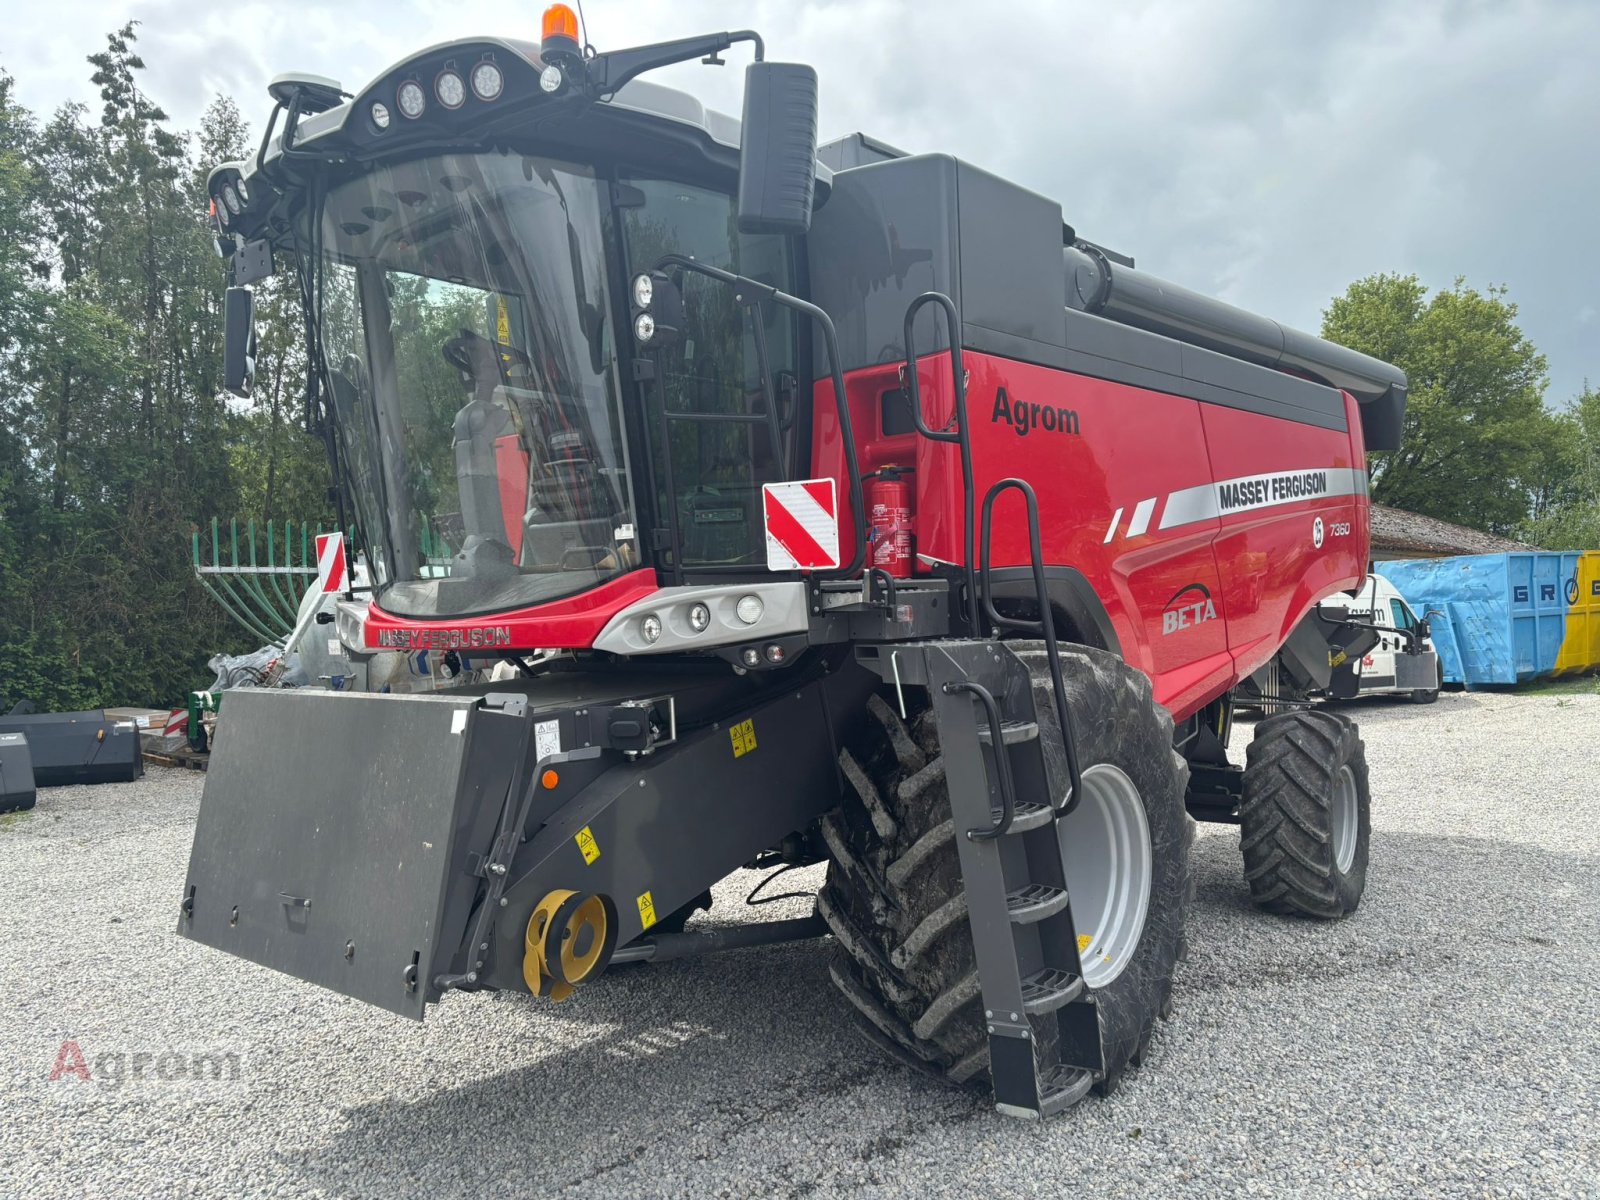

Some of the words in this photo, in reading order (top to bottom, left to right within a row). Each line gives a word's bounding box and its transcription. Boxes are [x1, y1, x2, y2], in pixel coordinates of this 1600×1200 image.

[991, 386, 1080, 436] Agrom
[1220, 479, 1269, 509] MASSEY
[1272, 472, 1326, 500] FERGUSON
[1329, 523, 1350, 537] 7360
[1162, 598, 1217, 636] BETA
[421, 626, 511, 649] FERGUSON
